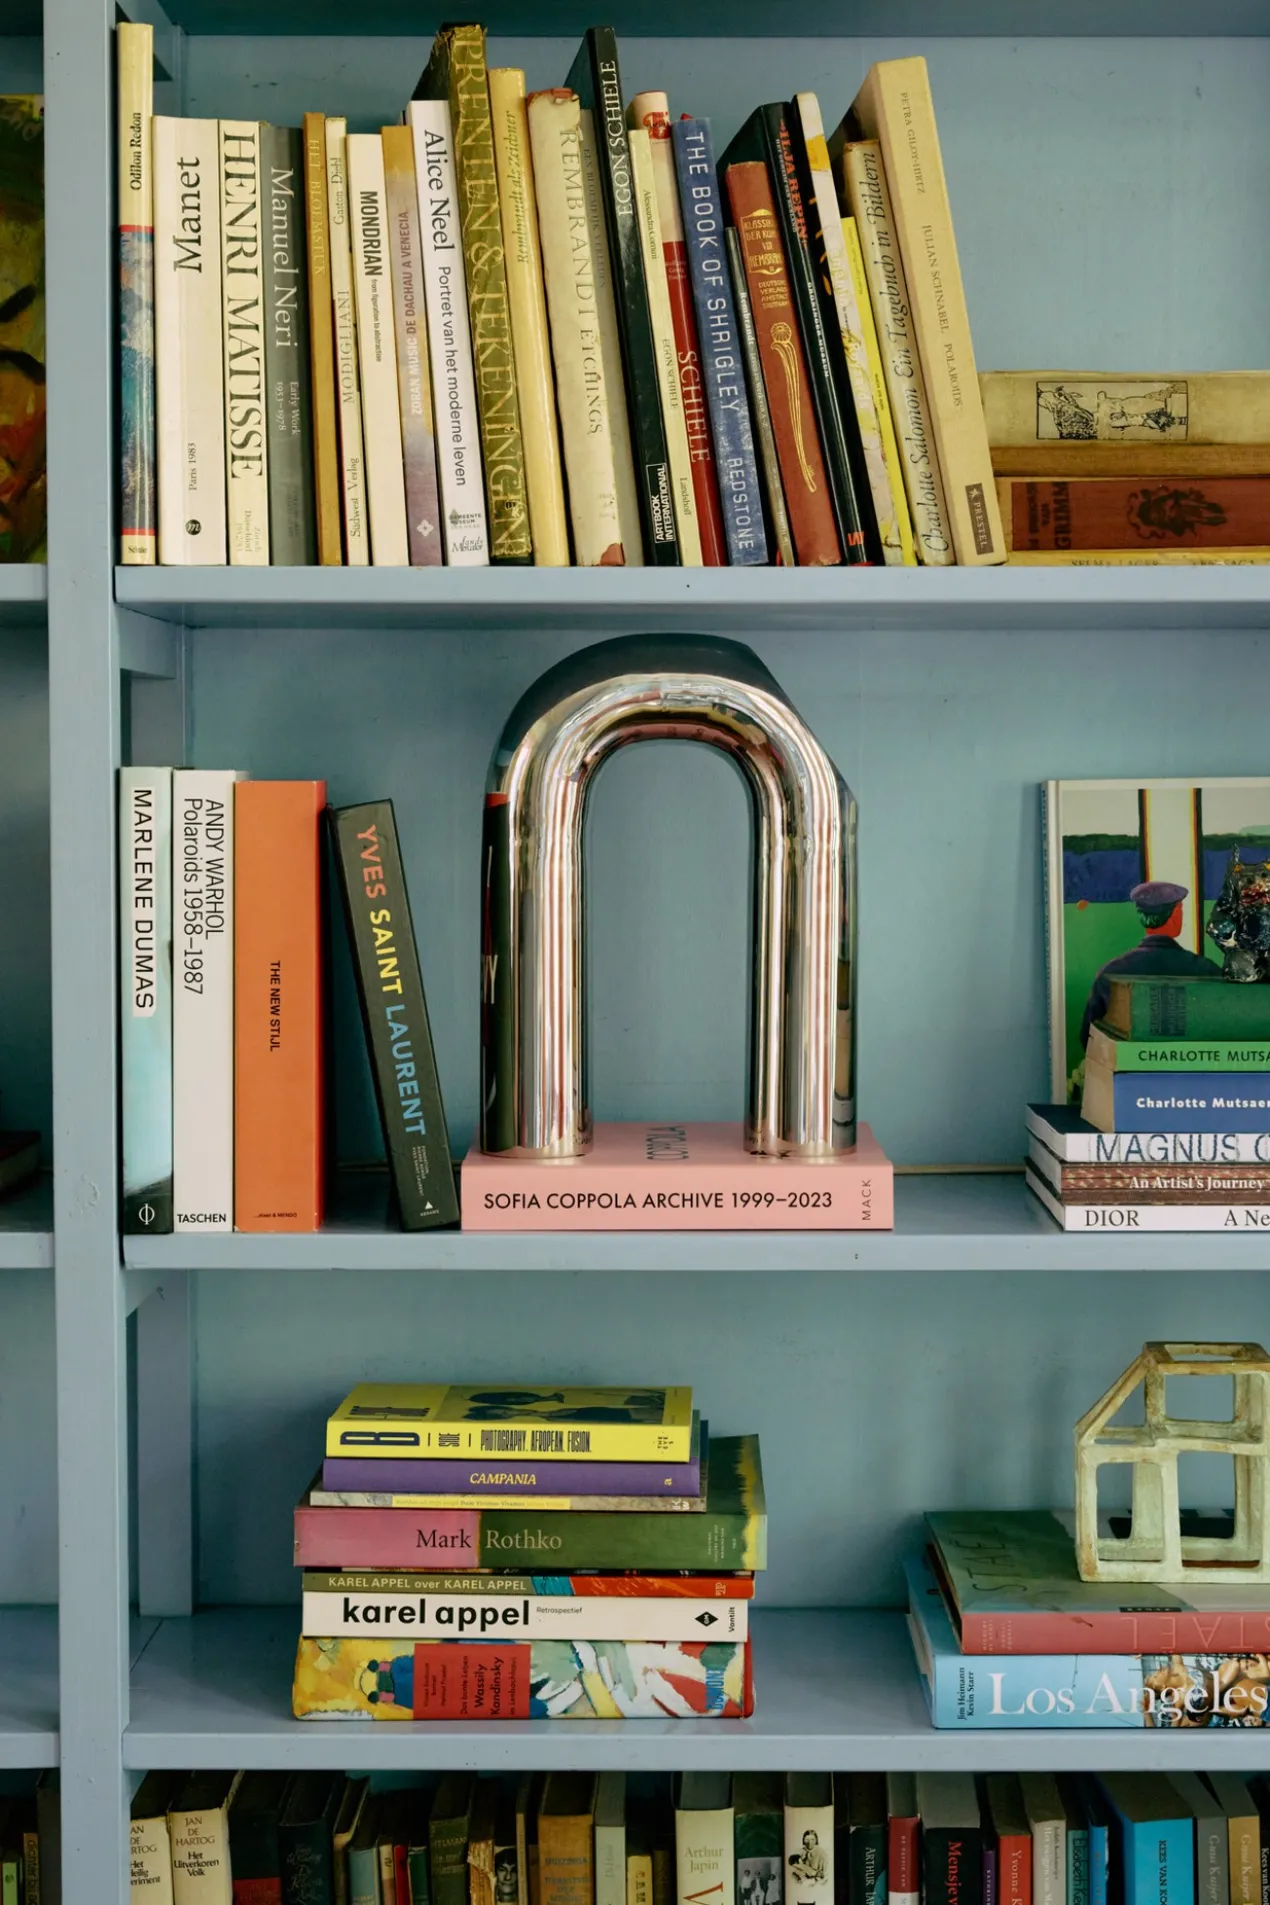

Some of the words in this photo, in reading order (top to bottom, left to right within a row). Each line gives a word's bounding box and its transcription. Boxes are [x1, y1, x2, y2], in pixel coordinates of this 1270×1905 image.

[600, 59, 626, 148] SCHIELE
[900, 92, 915, 127] PETRA
[130, 112, 142, 149] Redon
[451, 34, 502, 233] PRENTEN
[130, 150, 142, 191] Odilon
[307, 139, 322, 170] HET
[425, 130, 450, 191] Alice
[686, 131, 709, 176] THE
[779, 129, 798, 176] ILJA
[906, 128, 927, 196] GILOY-HIRTZ
[223, 130, 259, 279] HENRI
[610, 153, 634, 217] EGON
[858, 151, 889, 225] Bildern
[172, 156, 202, 274] Manet
[270, 165, 300, 275] Manuel
[310, 180, 326, 276] BLOEMSTUK
[332, 190, 345, 226] Gaston
[430, 197, 456, 252] Neel
[508, 190, 530, 265] Rembrandt
[642, 189, 658, 231] Alessandra
[692, 187, 719, 248] BOOK
[786, 178, 809, 241] REPIN
[360, 190, 383, 277] MONDRIAN
[398, 210, 413, 259] VENECIA
[871, 230, 892, 250] in
[921, 224, 939, 269] JULIAN
[402, 260, 412, 269] A
[468, 241, 506, 279] &
[702, 259, 724, 287] OF
[371, 278, 379, 294] from
[402, 276, 417, 318] DACHAU
[438, 266, 454, 318] Portret
[559, 130, 597, 320] REMBRANDT
[579, 329, 604, 435] ETCHINGS
[873, 253, 909, 344] Tagebuch
[930, 270, 952, 334] SCHNABEL
[273, 284, 298, 348] Neri
[371, 294, 381, 322] figuration
[405, 319, 418, 335] DE
[739, 291, 756, 347] Rembrandt
[336, 289, 355, 404] MODIGLIANI
[443, 320, 455, 346] van
[807, 282, 822, 338] GRONINGER
[818, 339, 830, 379] MUSEUM
[407, 337, 420, 375] MUSIC
[445, 349, 459, 374] het
[662, 339, 675, 367] EGON
[707, 297, 741, 412] SHRIGLEY
[892, 347, 915, 379] Ein
[227, 293, 263, 479] MATISSE
[288, 380, 300, 406] Early
[666, 370, 679, 410] SCHIELE
[943, 342, 964, 408] POLAROIDS
[410, 378, 424, 416] ZORAN
[447, 376, 464, 443] moderne
[677, 350, 711, 464] SCHIELE
[290, 408, 302, 436] Work
[471, 281, 534, 557] TEKENINGEN
[904, 387, 932, 465] Salomon
[187, 442, 198, 465] 1983
[453, 446, 468, 488] leven
[188, 467, 198, 491] Paris
[679, 476, 692, 516] Landshoff
[651, 495, 665, 541] ARTBOOK
[656, 465, 675, 541] INTERNATIONAL
[727, 458, 755, 551] REDSTONE
[916, 470, 950, 552] Charlotte
[973, 501, 989, 550] PRESTEL
[183, 798, 203, 884] Polaroids
[205, 799, 225, 853] ANDY
[134, 789, 153, 909] MARLENE
[356, 824, 388, 899] YVES
[205, 857, 225, 941] WARHOL
[183, 888, 204, 996] 1958–1987
[369, 909, 404, 995] SAINT
[134, 919, 155, 1009] DUMAS
[269, 960, 281, 985] THE
[269, 987, 281, 1017] NEW
[269, 1018, 281, 1053] STIJL
[1138, 1050, 1221, 1062] CHARLOTTE
[384, 1004, 427, 1136] LAURENT
[1136, 1097, 1207, 1109] Charlotte
[1096, 1134, 1237, 1162] MAGNUS
[483, 1192, 541, 1210] SOFIA
[546, 1192, 637, 1210] COPPOLA
[641, 1192, 724, 1210] ARCHIVE
[731, 1191, 833, 1210] 1999–2023
[861, 1179, 872, 1222] MACK
[1129, 1176, 1149, 1190] An
[1205, 1176, 1267, 1193] Journey
[177, 1213, 227, 1224] TASCHEN
[1085, 1209, 1140, 1226] DIOR
[1224, 1210, 1238, 1226] A
[469, 1472, 538, 1486] CAMPANIA
[415, 1528, 472, 1550] Mark
[485, 1527, 563, 1550] Rothko
[328, 1576, 369, 1589] KAREL
[371, 1576, 411, 1589] APPEL
[414, 1579, 441, 1590] over
[443, 1577, 482, 1591] KAREL
[484, 1578, 527, 1592] APPEL
[342, 1597, 426, 1625] karel
[434, 1599, 530, 1632] appel
[536, 1606, 583, 1616] Retrospectief
[728, 1606, 737, 1633] Vantilt
[461, 1656, 470, 1679] Leben
[474, 1663, 488, 1709] Wassily
[490, 1657, 505, 1715] Kandinsky
[957, 1666, 966, 1702] Heimann
[966, 1670, 975, 1693] Starr
[460, 1680, 468, 1701] bunte
[460, 1701, 468, 1715] Das
[966, 1694, 974, 1717] Kevin
[987, 1671, 1076, 1716] Los
[1084, 1669, 1269, 1723] Angeles
[957, 1703, 967, 1721] Jim
[175, 1835, 216, 1847] HARTOG
[184, 1816, 203, 1827] JAN
[187, 1828, 201, 1837] DE
[187, 1851, 204, 1860] Het
[187, 1868, 206, 1877] Volk
[685, 1847, 724, 1859] Arthur
[690, 1860, 720, 1874] Japin
[864, 1847, 876, 1886] ARTHUR
[944, 1840, 963, 1898] Mensje
[1011, 1849, 1022, 1894] Yvonne
[1158, 1839, 1168, 1864] KEES
[1260, 1847, 1270, 1868] Kees
[1159, 1865, 1168, 1886] VAN
[1261, 1868, 1270, 1885] van
